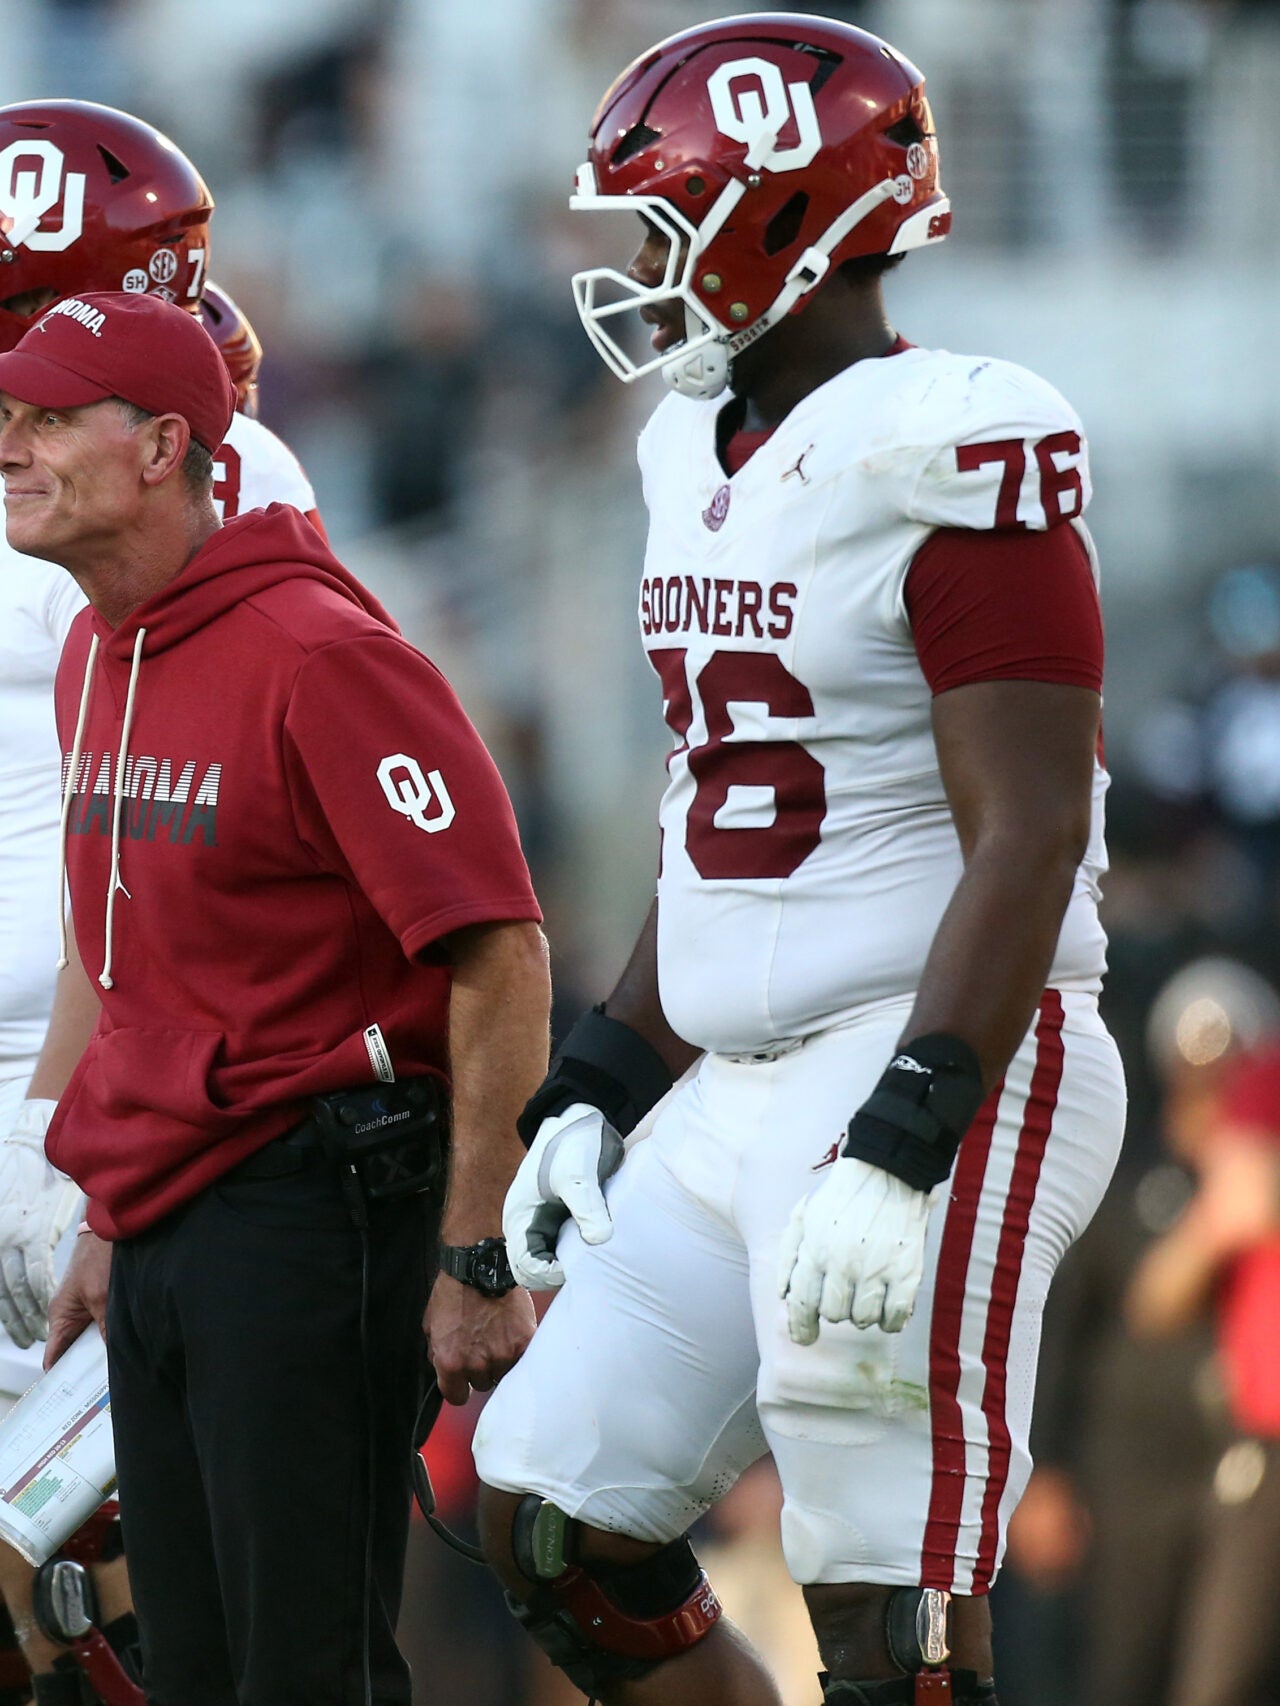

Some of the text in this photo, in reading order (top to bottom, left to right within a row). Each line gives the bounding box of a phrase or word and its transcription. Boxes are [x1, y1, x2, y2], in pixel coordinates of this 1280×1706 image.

[706, 57, 822, 173] OU
[126, 276, 145, 289] SH
[151, 252, 175, 281] SEC
[956, 430, 1082, 530] 76
[642, 575, 797, 640] SOONERS
[376, 753, 456, 833] OU
[355, 1111, 410, 1134] CoachComm
